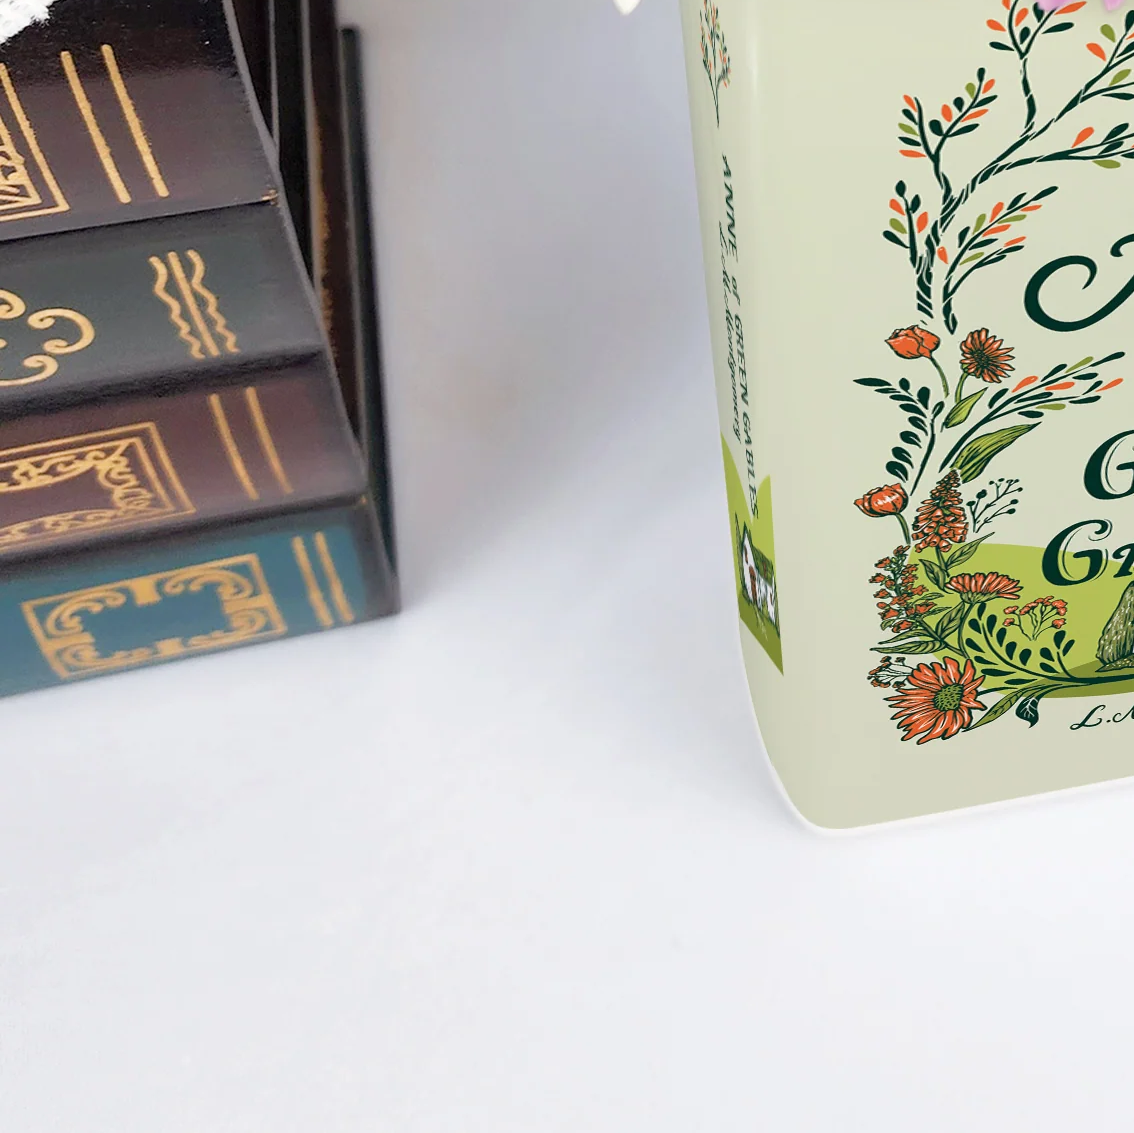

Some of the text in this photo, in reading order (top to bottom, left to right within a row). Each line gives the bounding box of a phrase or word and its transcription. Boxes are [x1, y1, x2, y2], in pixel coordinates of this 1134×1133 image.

[721, 154, 759, 519] ANNE of GREEN GABLES
